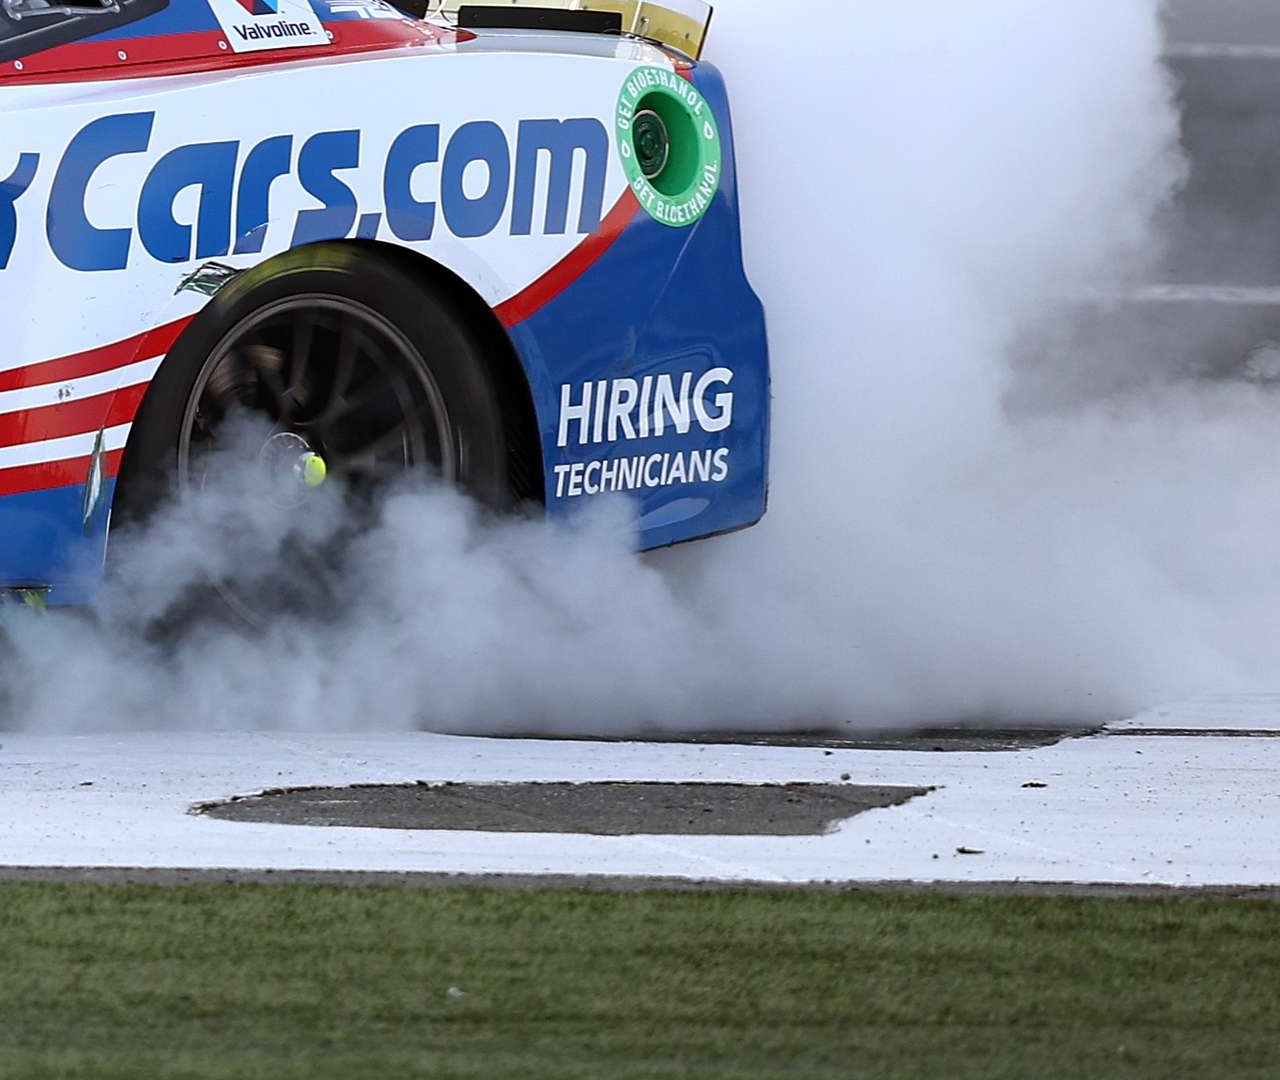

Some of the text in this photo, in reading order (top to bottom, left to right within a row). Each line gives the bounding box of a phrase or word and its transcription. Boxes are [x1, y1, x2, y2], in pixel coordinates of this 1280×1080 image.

[233, 21, 312, 41] Valvoline
[617, 68, 703, 130] GET BIOETHANOL
[634, 161, 718, 222] GET BIOETHANOL
[557, 367, 734, 447] HIRING
[554, 447, 729, 498] TECHNICIANS
